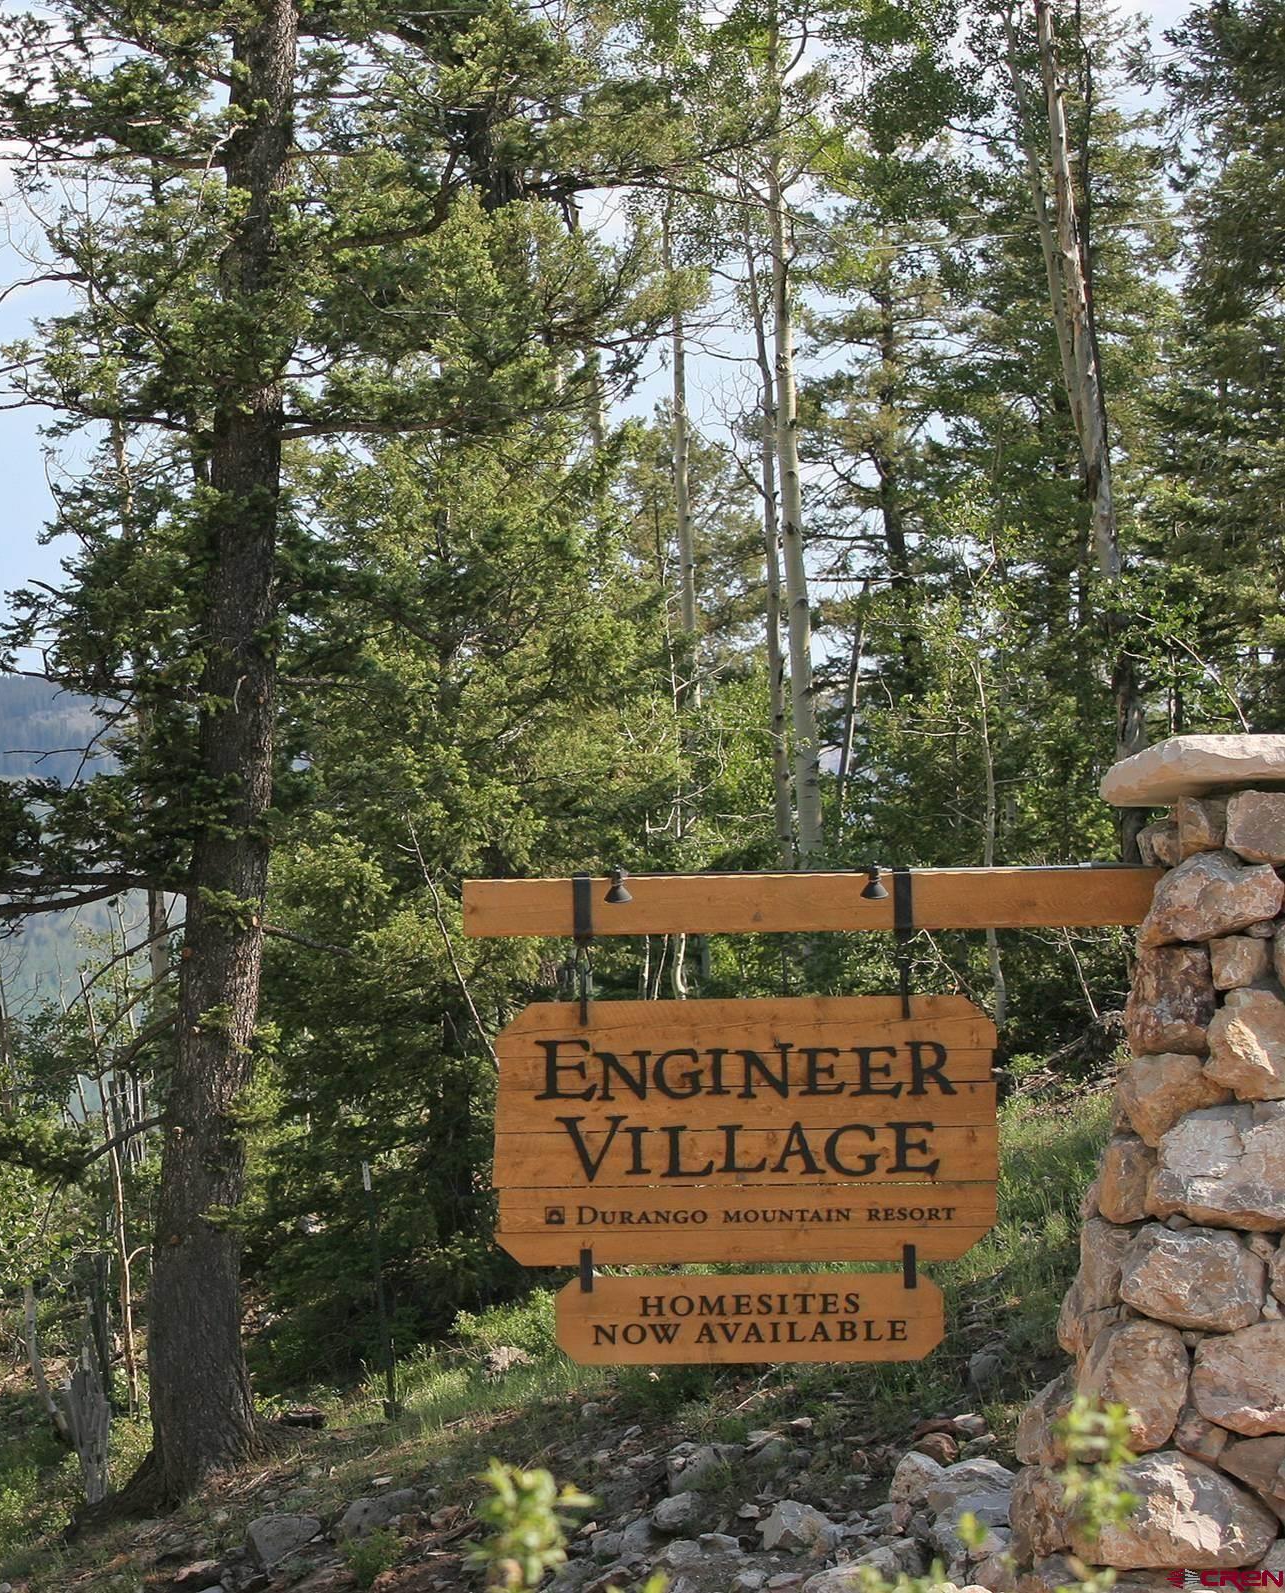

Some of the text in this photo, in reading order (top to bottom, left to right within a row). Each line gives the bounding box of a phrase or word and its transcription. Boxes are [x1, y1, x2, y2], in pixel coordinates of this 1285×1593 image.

[534, 1038, 958, 1101] ENGINEER
[554, 1115, 941, 1183] VILLAGE
[576, 1205, 957, 1226] DURANGO MOUNTAIN RESORT
[638, 1292, 861, 1318] HOMESITES
[592, 1319, 908, 1346] NOW AVAILABLE
